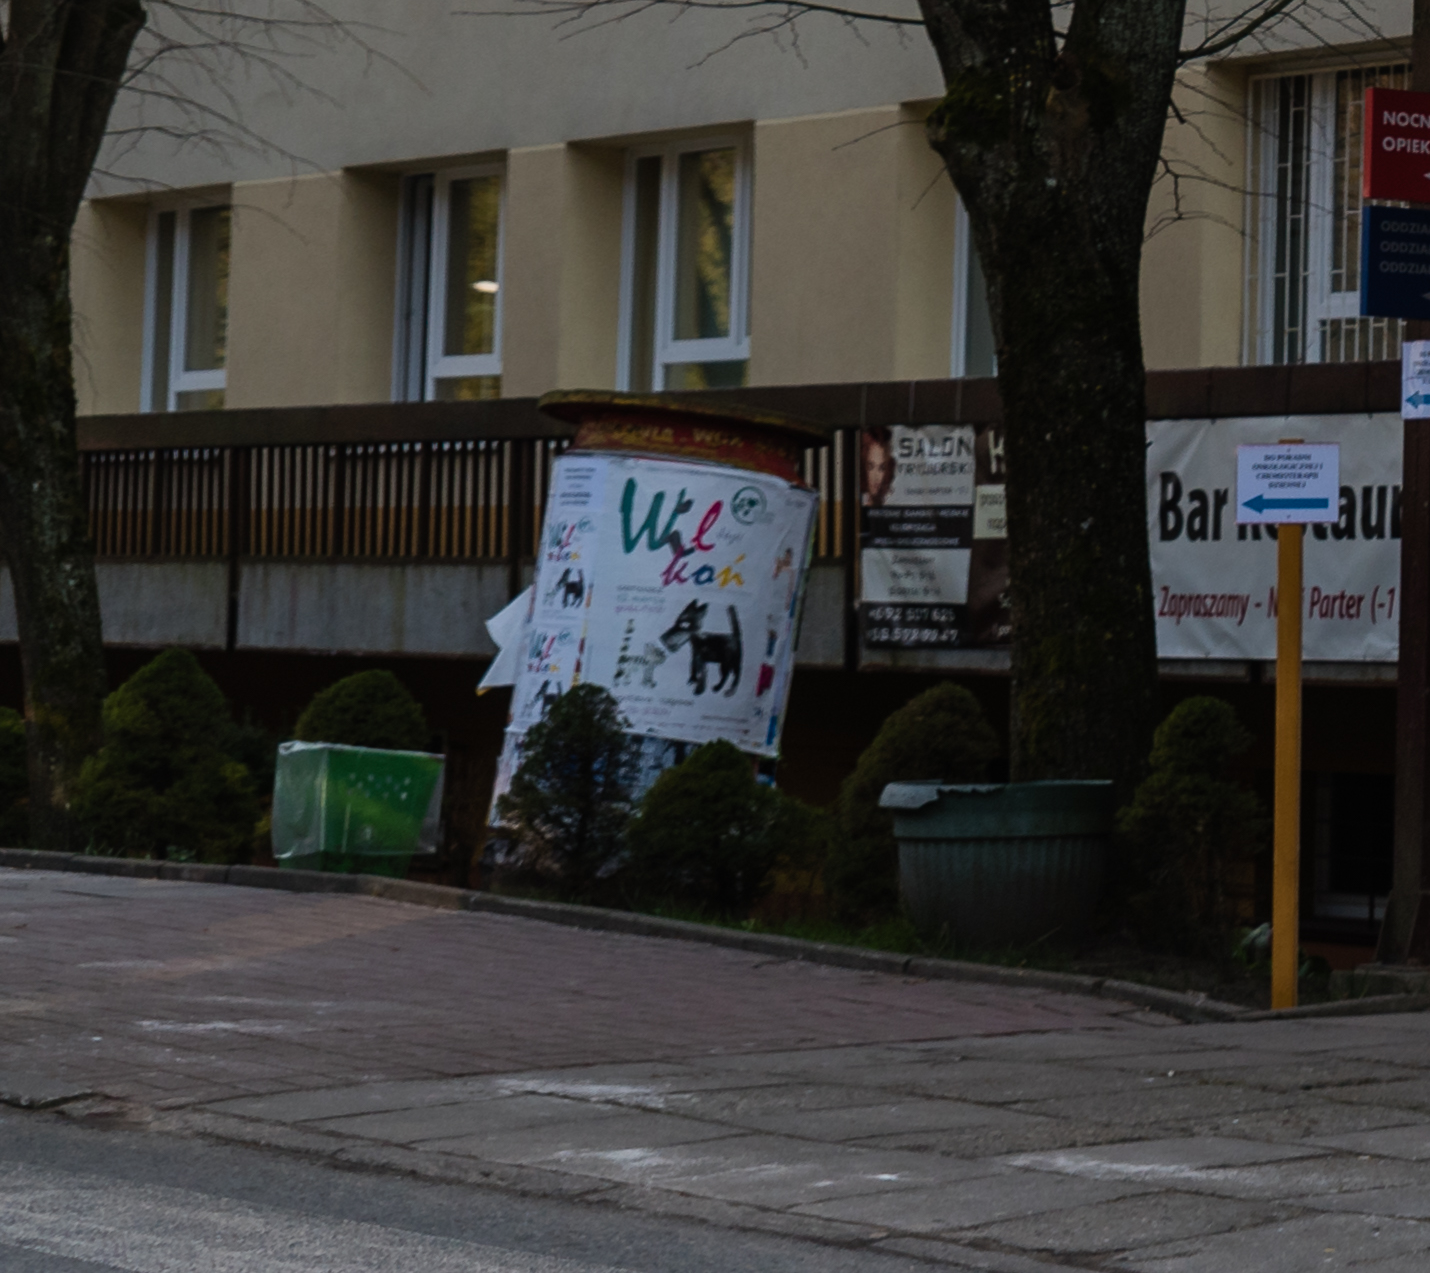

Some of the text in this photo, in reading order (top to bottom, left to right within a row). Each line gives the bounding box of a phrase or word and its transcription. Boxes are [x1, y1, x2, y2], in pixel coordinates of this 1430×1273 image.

[1159, 471, 1228, 542] Bar
[1159, 586, 1249, 626] Zapraszamy
[1309, 586, 1365, 620] Parter
[1371, 585, 1395, 625] (-1
